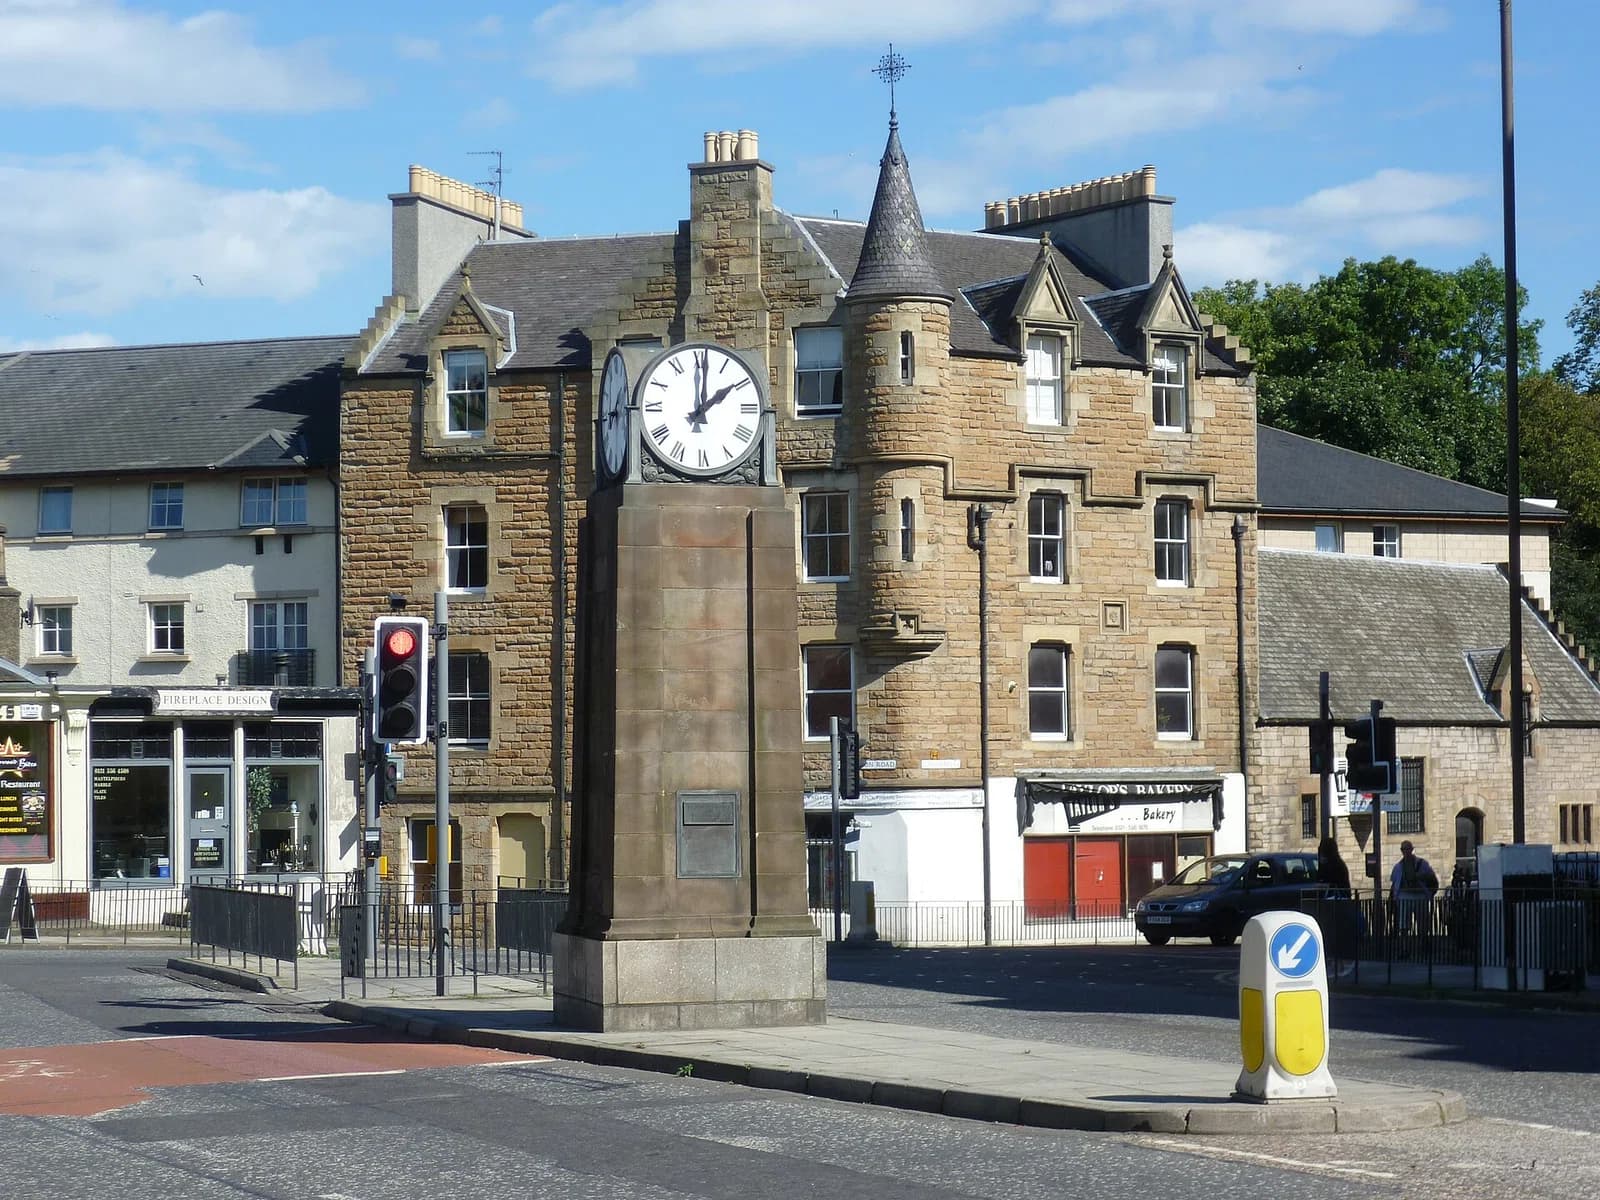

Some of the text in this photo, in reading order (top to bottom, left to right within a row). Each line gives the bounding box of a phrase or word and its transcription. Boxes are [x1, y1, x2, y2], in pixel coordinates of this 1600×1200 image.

[163, 695, 267, 705] FIREPLACE DESIGN
[1, 780, 41, 788] Restaurant
[1143, 808, 1176, 824] Bakery
